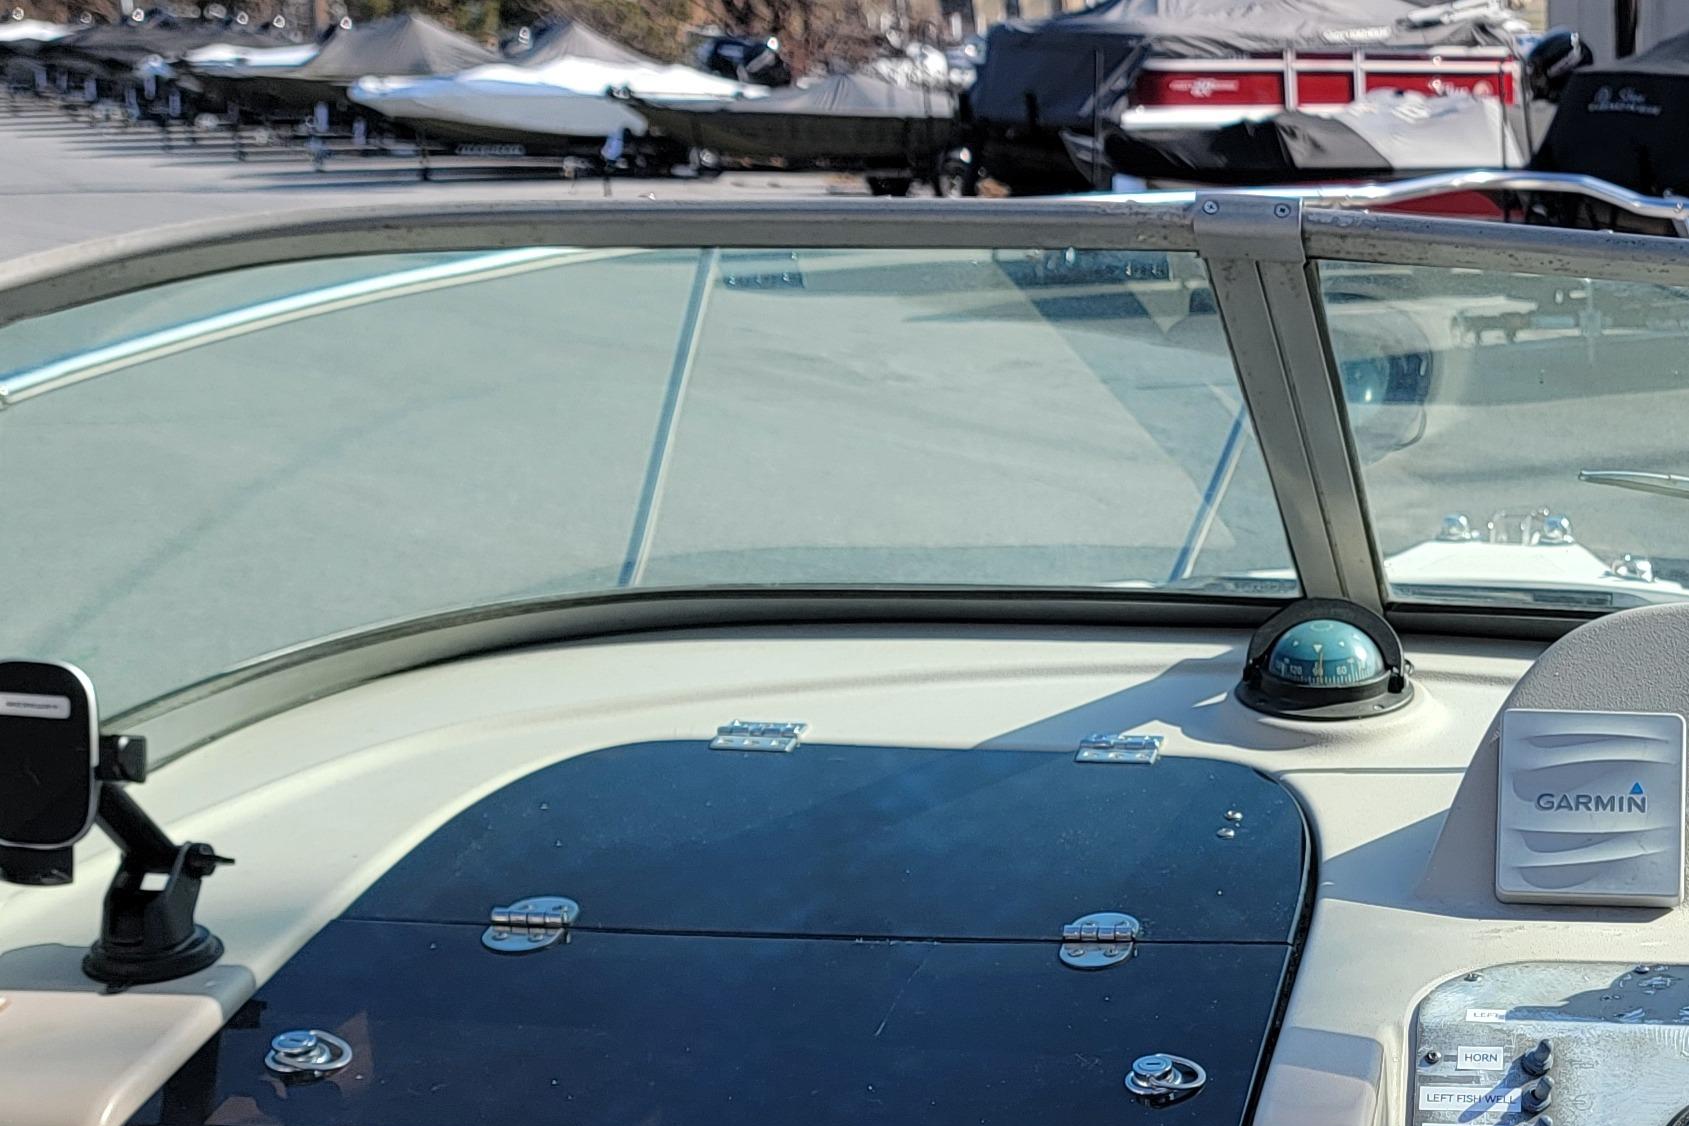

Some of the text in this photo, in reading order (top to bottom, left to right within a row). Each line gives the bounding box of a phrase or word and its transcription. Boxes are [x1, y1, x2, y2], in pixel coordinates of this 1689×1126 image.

[1536, 793, 1647, 813] GARMIN
[1464, 1053, 1498, 1063] HORN
[1426, 1093, 1516, 1105] LEFT FISH WELL
